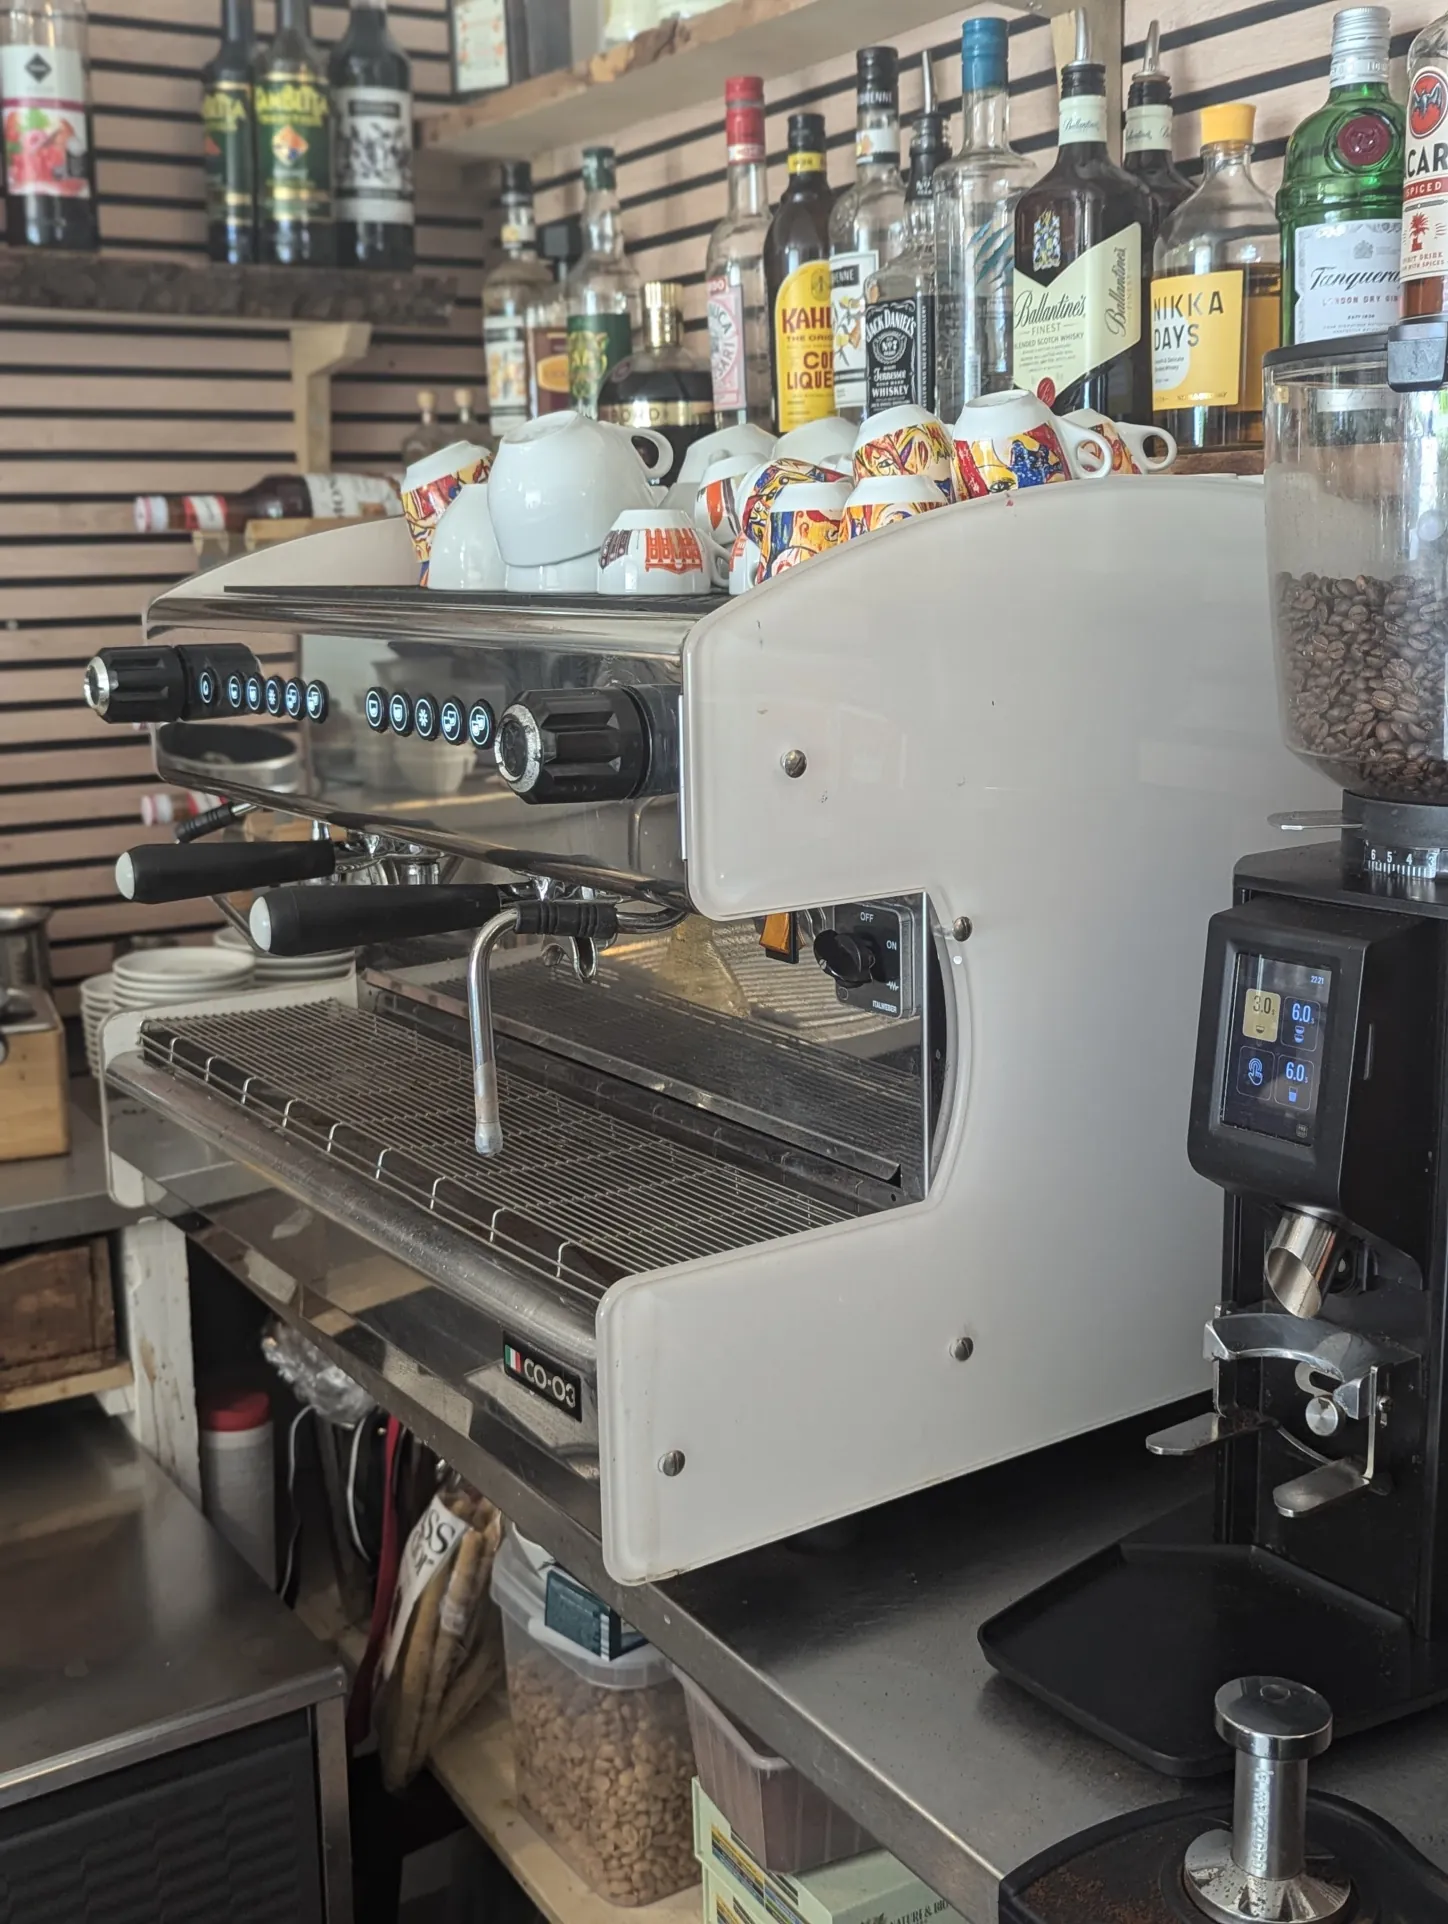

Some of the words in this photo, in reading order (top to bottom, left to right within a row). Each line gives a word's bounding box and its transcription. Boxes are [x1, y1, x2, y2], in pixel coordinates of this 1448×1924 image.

[1406, 181, 1442, 199] SPICED
[1419, 251, 1444, 261] DRINK
[1422, 259, 1445, 268] SPICES
[1104, 246, 1127, 338] Ballantine's
[1363, 295, 1381, 304] DRY
[1014, 290, 1087, 329] Ballantine's
[1154, 290, 1224, 320] NIKKA
[866, 314, 885, 343] JACK
[884, 309, 917, 337] DANIEL'S
[1031, 322, 1061, 336] FINEST
[1037, 334, 1060, 346] SCOTCH
[1060, 331, 1085, 342] WHISKY
[1154, 323, 1199, 351] DAYS
[872, 384, 909, 398] WHISKEY
[1371, 849, 1376, 860] 6
[1387, 851, 1393, 863] 5
[1406, 854, 1413, 865] 4
[860, 911, 874, 923] OFF
[886, 940, 897, 950] ON
[1253, 995, 1272, 1015] 3.0
[1292, 1002, 1311, 1023] 6.0
[1286, 1061, 1305, 1082] 6.0
[924, 1906, 932, 1918] &
